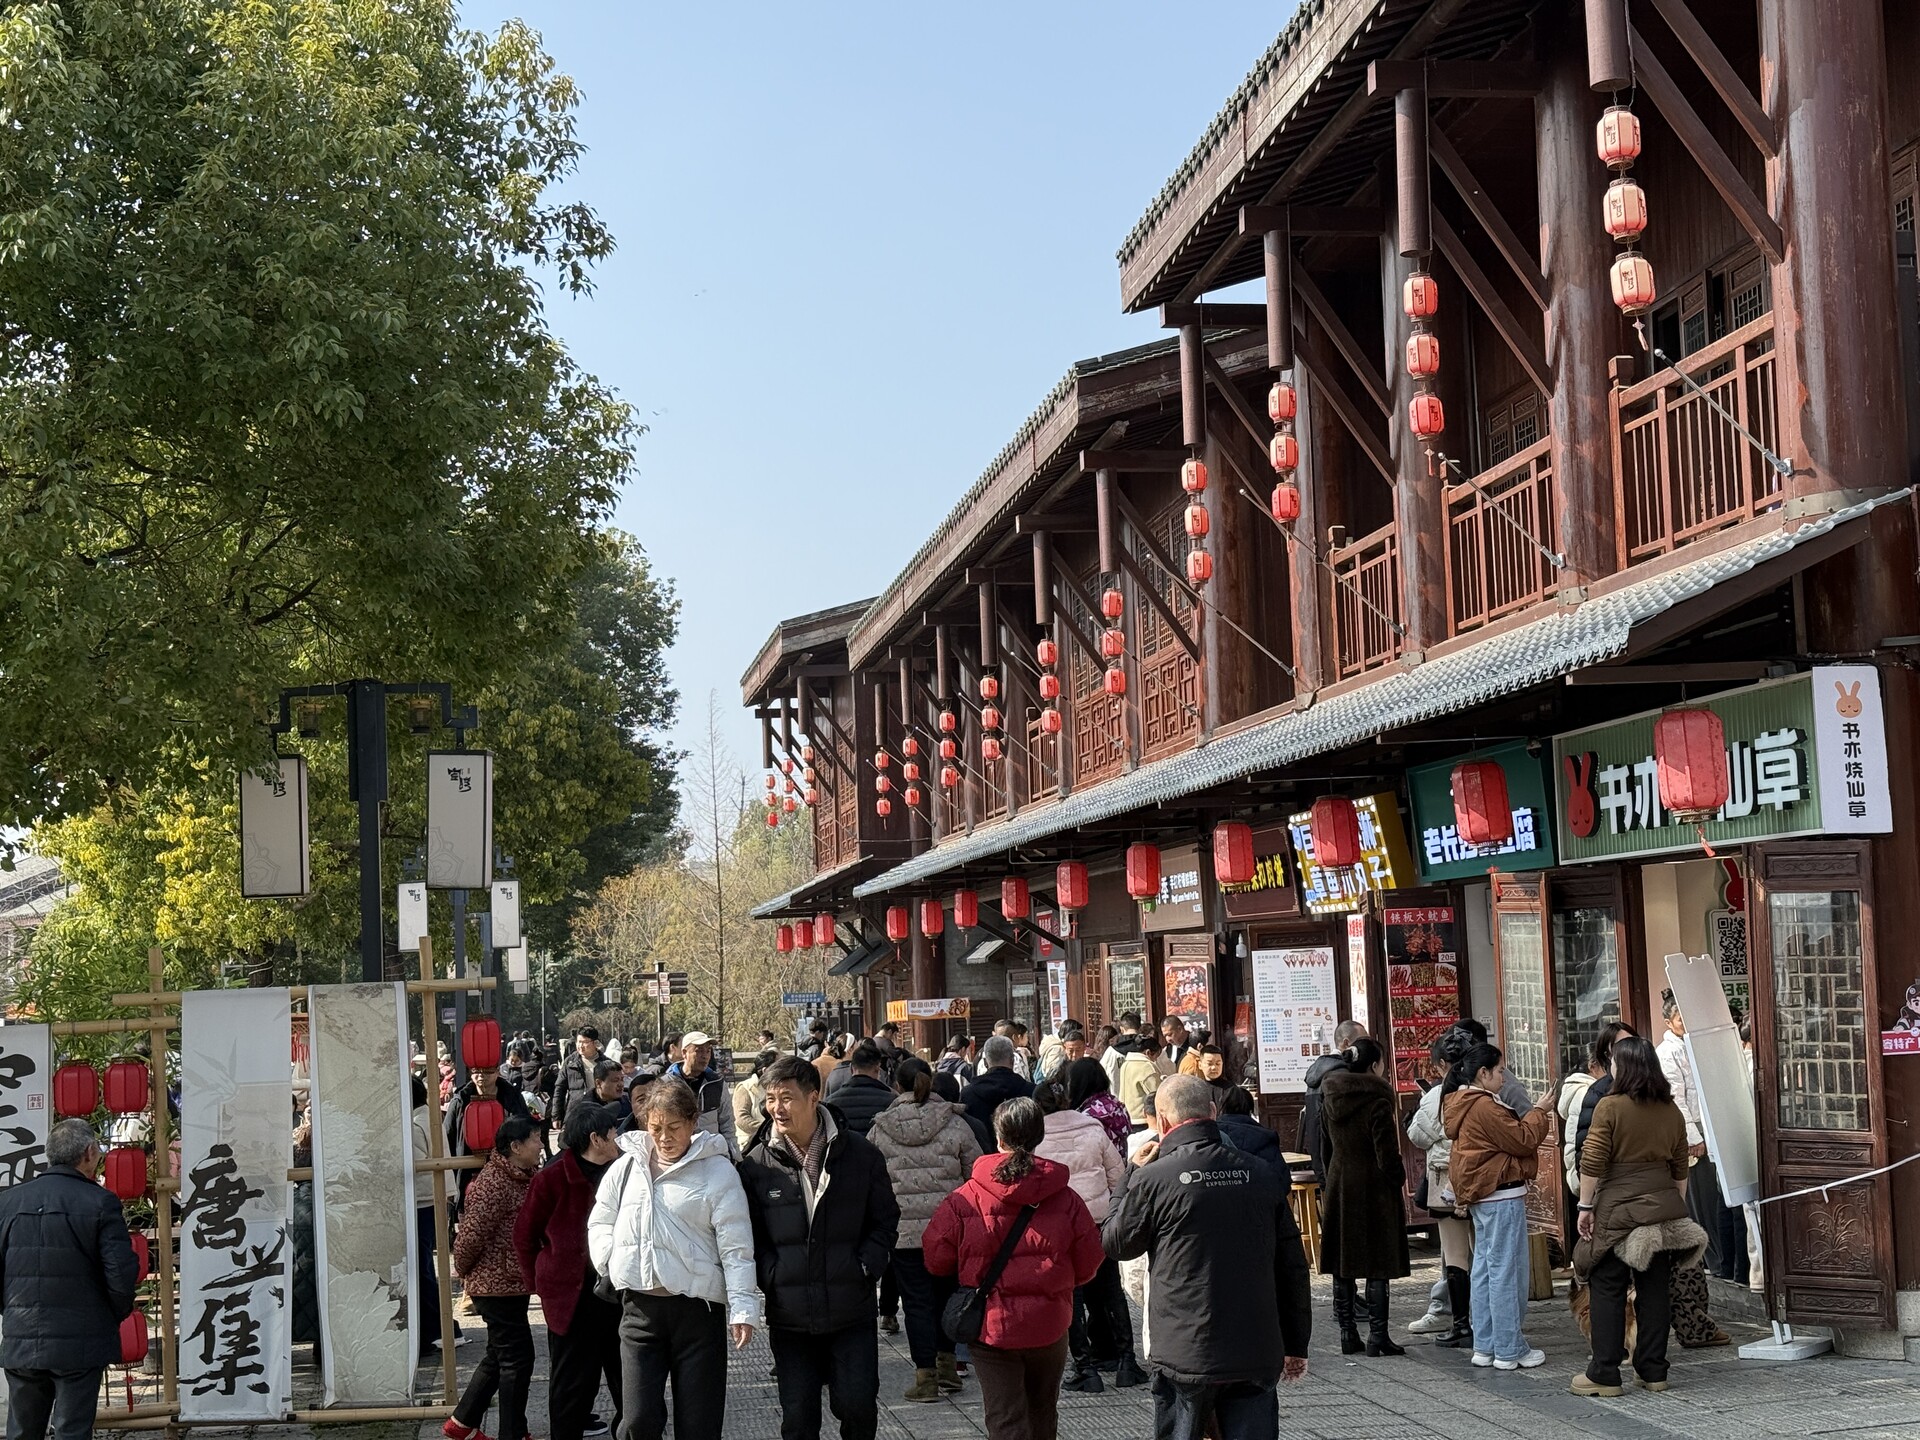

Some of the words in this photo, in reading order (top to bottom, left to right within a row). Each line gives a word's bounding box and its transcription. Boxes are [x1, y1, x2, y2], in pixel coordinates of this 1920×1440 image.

[1841, 722, 1867, 819] 书亦烧仙草
[1599, 727, 1801, 835] 书亦仙草
[1423, 807, 1537, 865] 老长沙腐
[1390, 909, 1450, 924] 铁板大鱿鱼
[1440, 952, 1456, 962] 20元
[1730, 997, 1750, 1011] 免
[1189, 1169, 1250, 1184] Discovery
[1205, 1180, 1243, 1188] EXPEDITION
